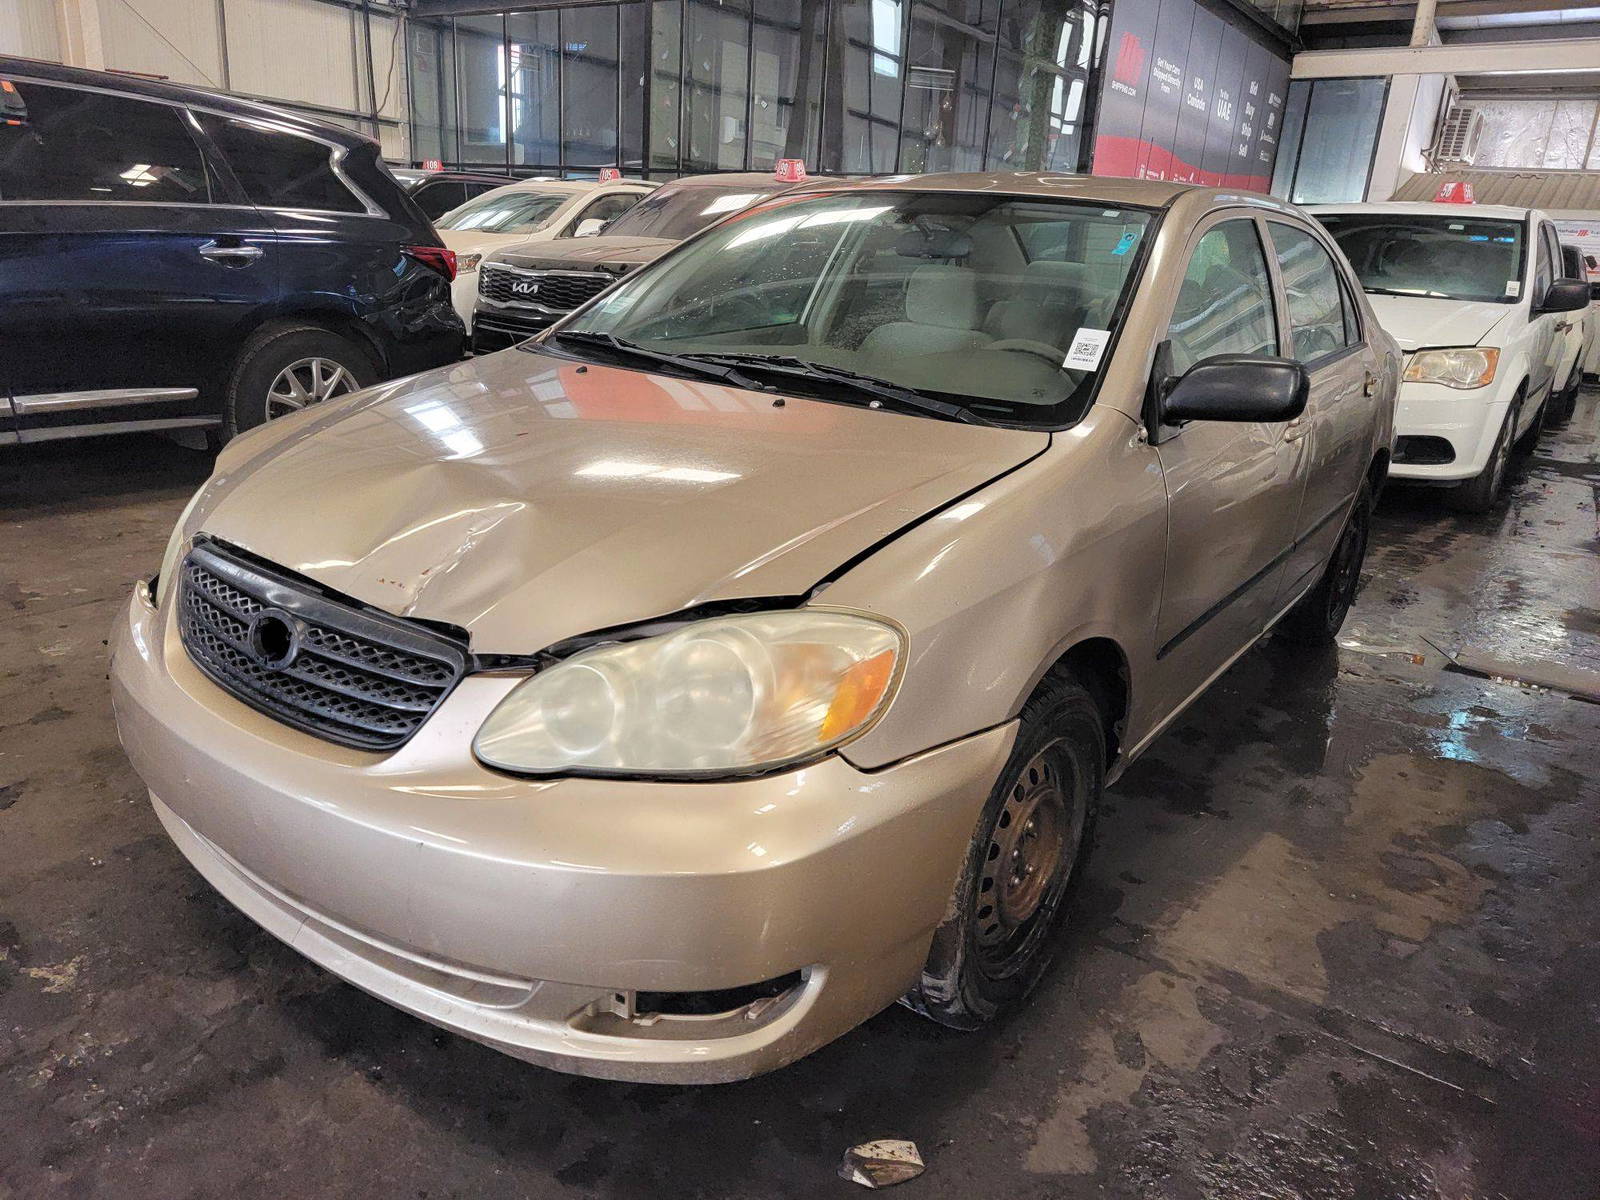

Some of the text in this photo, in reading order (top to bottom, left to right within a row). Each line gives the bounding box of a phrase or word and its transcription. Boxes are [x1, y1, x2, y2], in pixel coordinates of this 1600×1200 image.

[1111, 80, 1137, 97] SHIPPING.COM
[1194, 76, 1204, 92] USA
[1249, 81, 1259, 96] Bid
[1187, 93, 1206, 112] Canada
[1217, 99, 1232, 121] UAE
[1245, 102, 1256, 121] Buy
[1241, 122, 1252, 142] Ship
[1239, 143, 1248, 158] Sell
[425, 160, 438, 170] 108
[600, 167, 613, 181] 105
[512, 282, 539, 294] KIA
